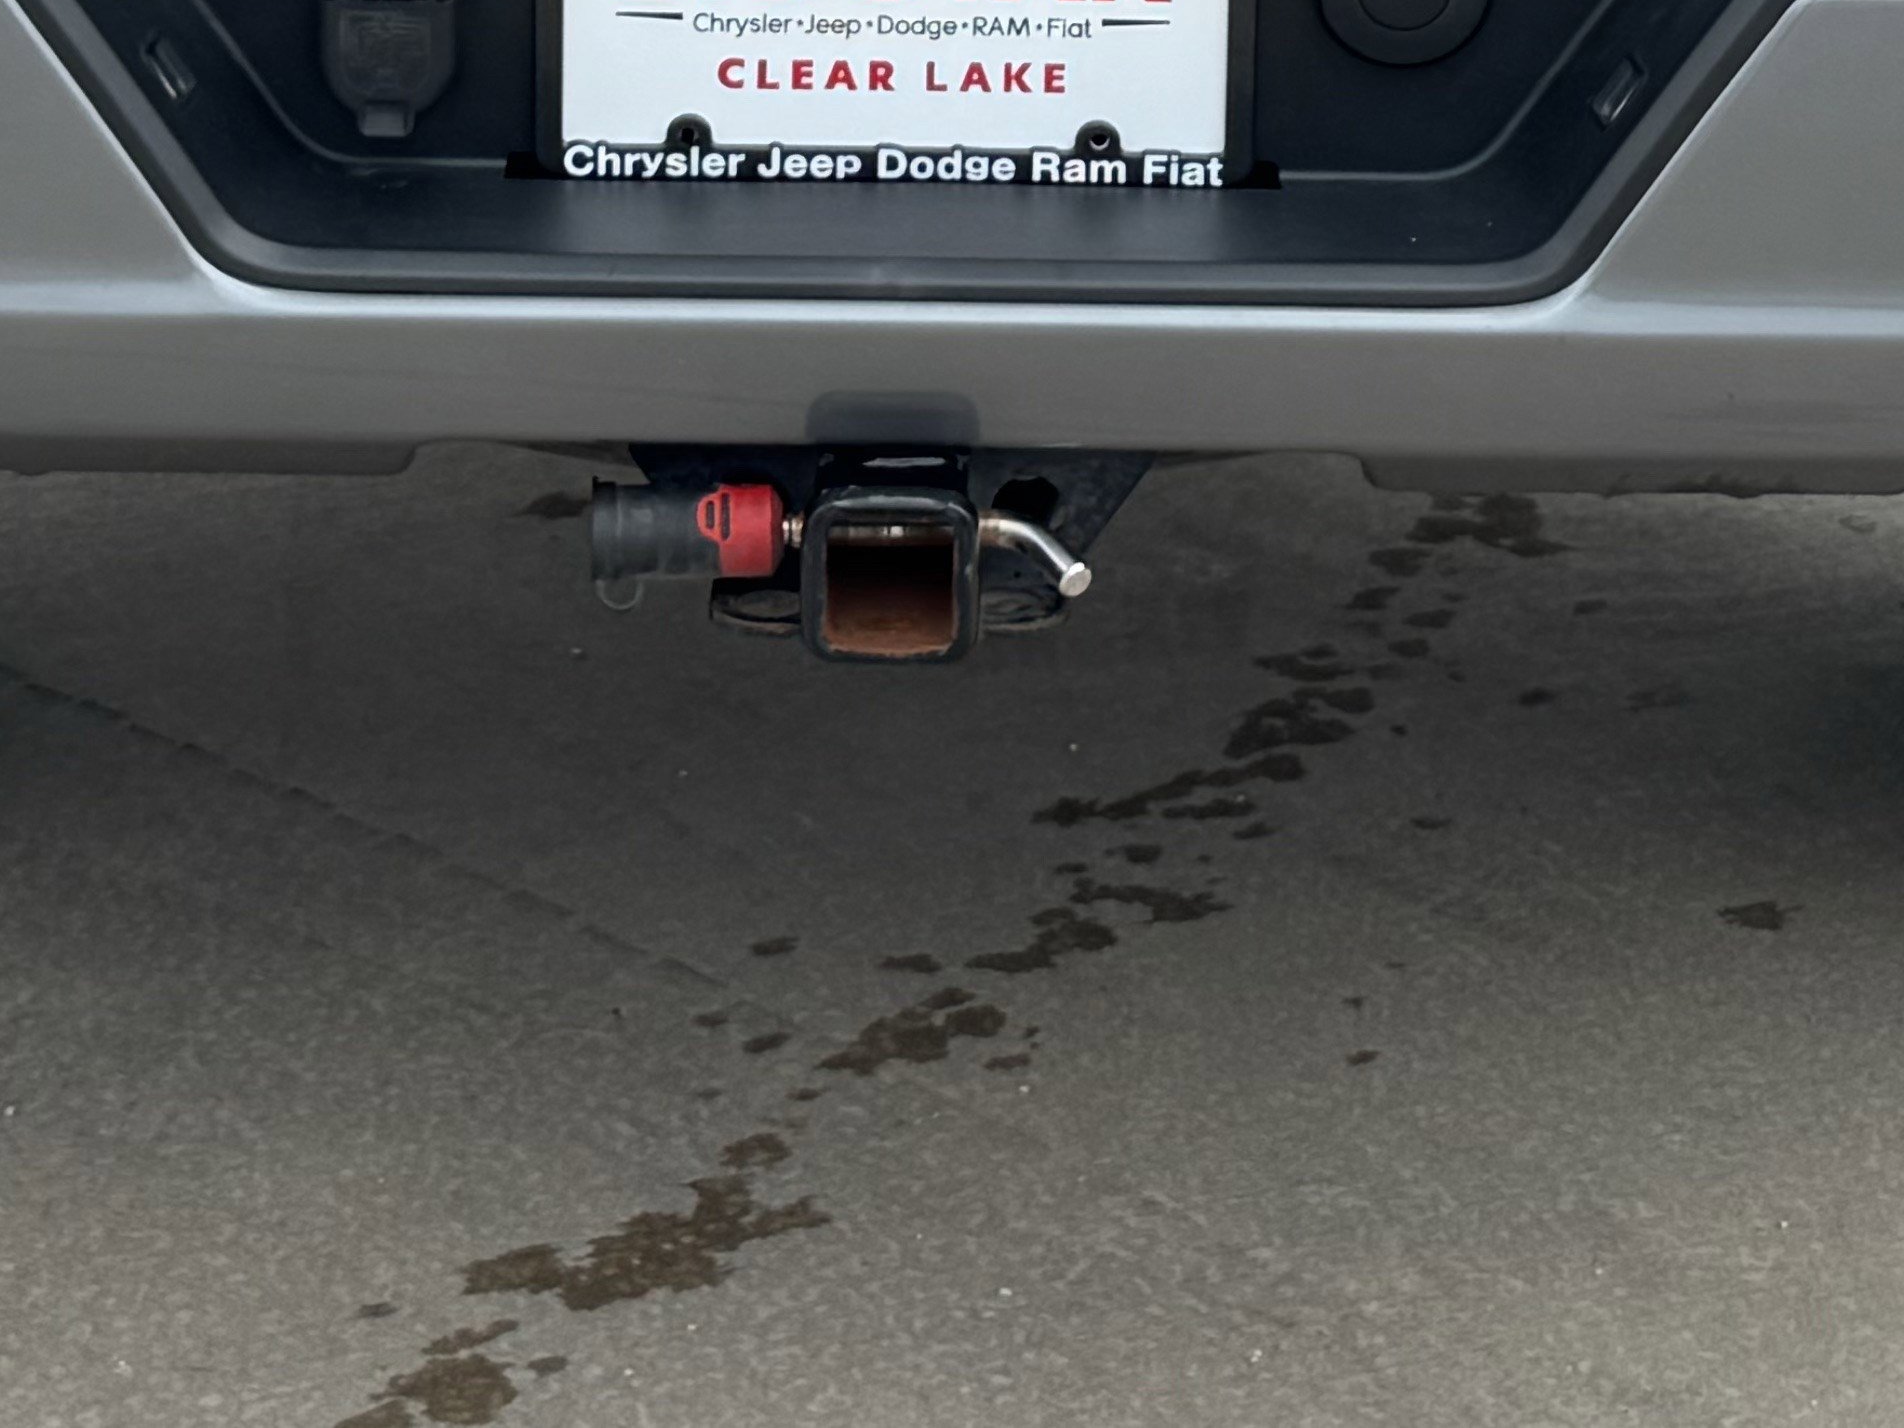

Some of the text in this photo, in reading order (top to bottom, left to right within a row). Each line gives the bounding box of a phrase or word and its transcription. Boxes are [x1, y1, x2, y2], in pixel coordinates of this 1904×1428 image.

[717, 57, 1067, 94] CLEAR LAKE
[563, 144, 1224, 187] Chrysler Jeep Dodge Ram Fiat
